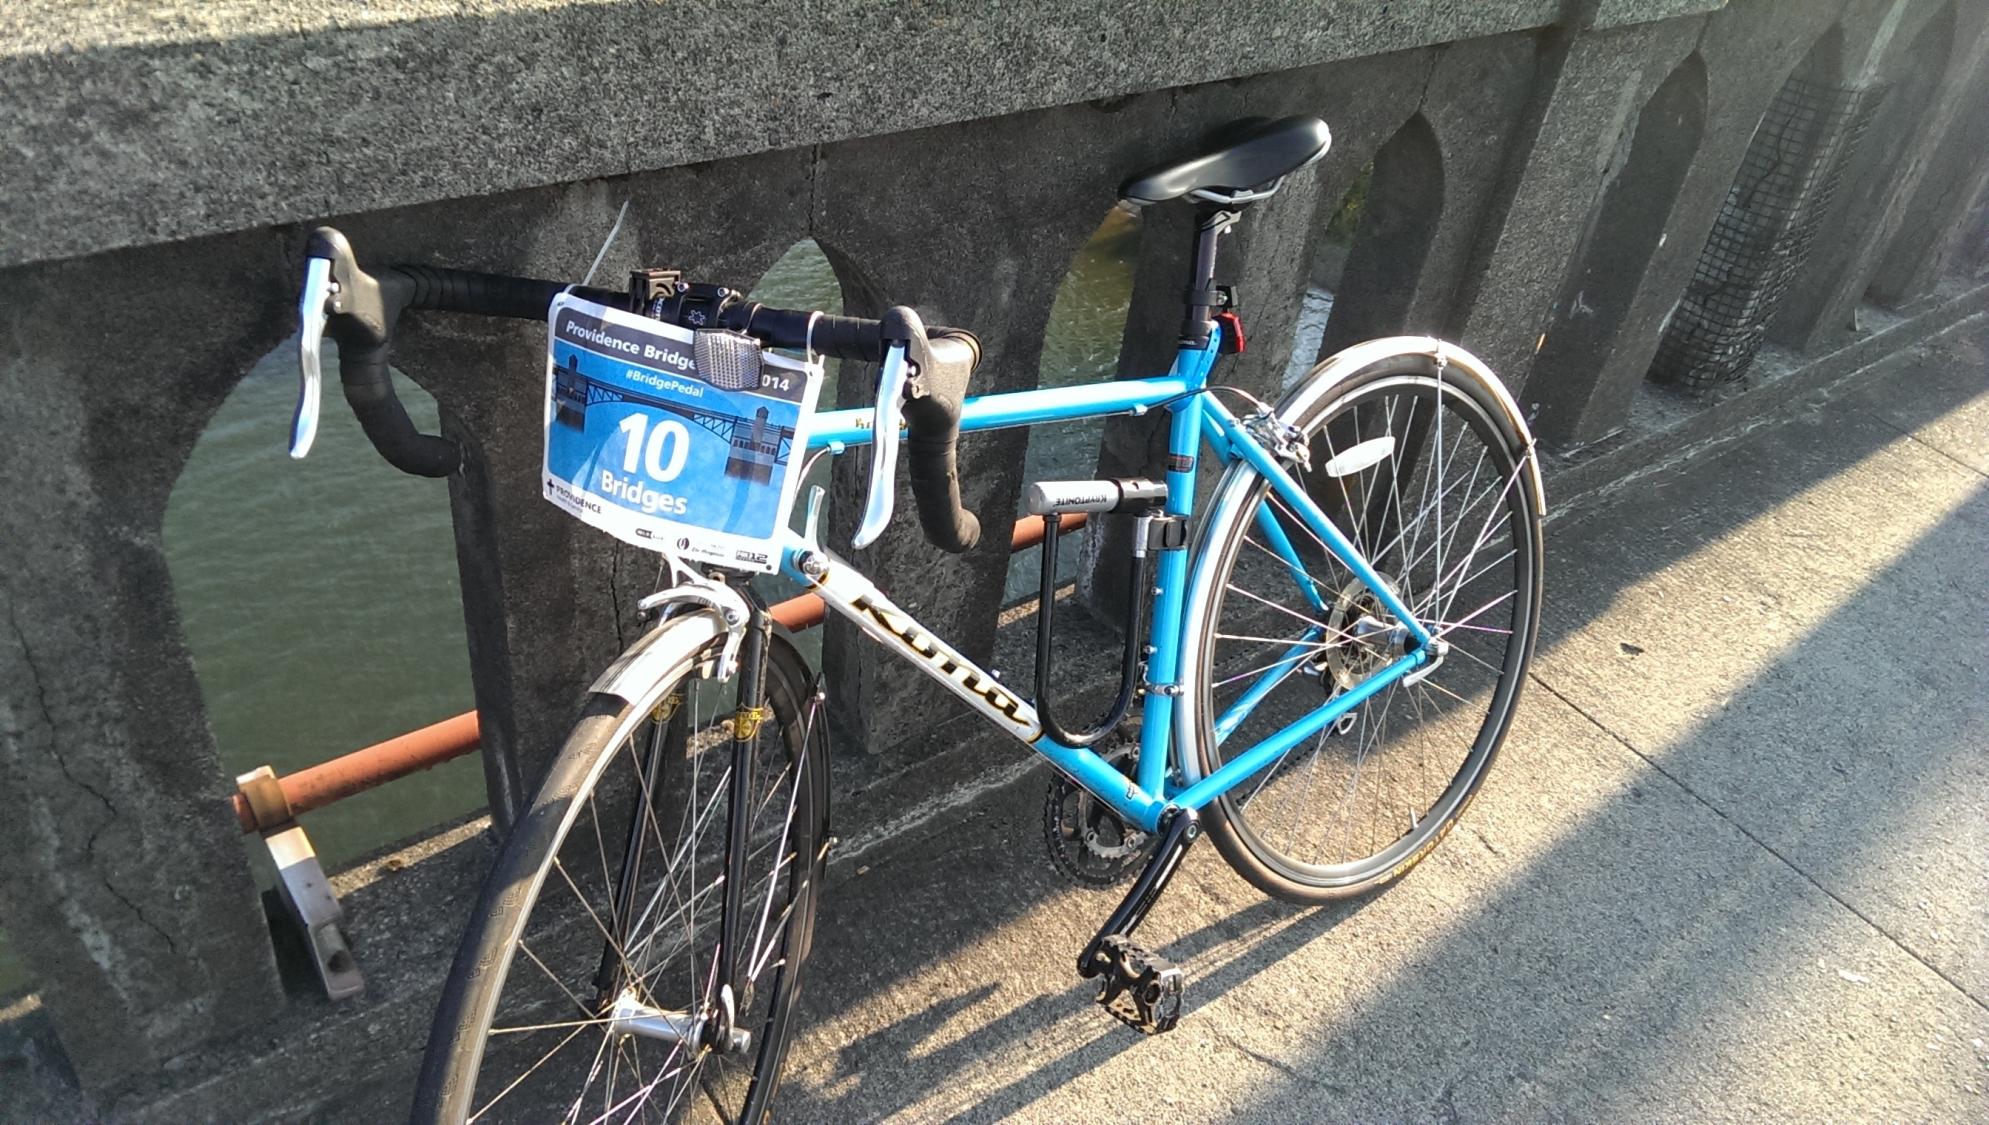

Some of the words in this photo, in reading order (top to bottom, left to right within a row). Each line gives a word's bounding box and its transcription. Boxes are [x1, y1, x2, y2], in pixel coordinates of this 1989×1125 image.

[565, 320, 641, 355] Providence
[761, 374, 790, 392] 014
[626, 369, 704, 398] #BridgePedal
[618, 412, 690, 483] 10
[601, 469, 689, 516] Bridges
